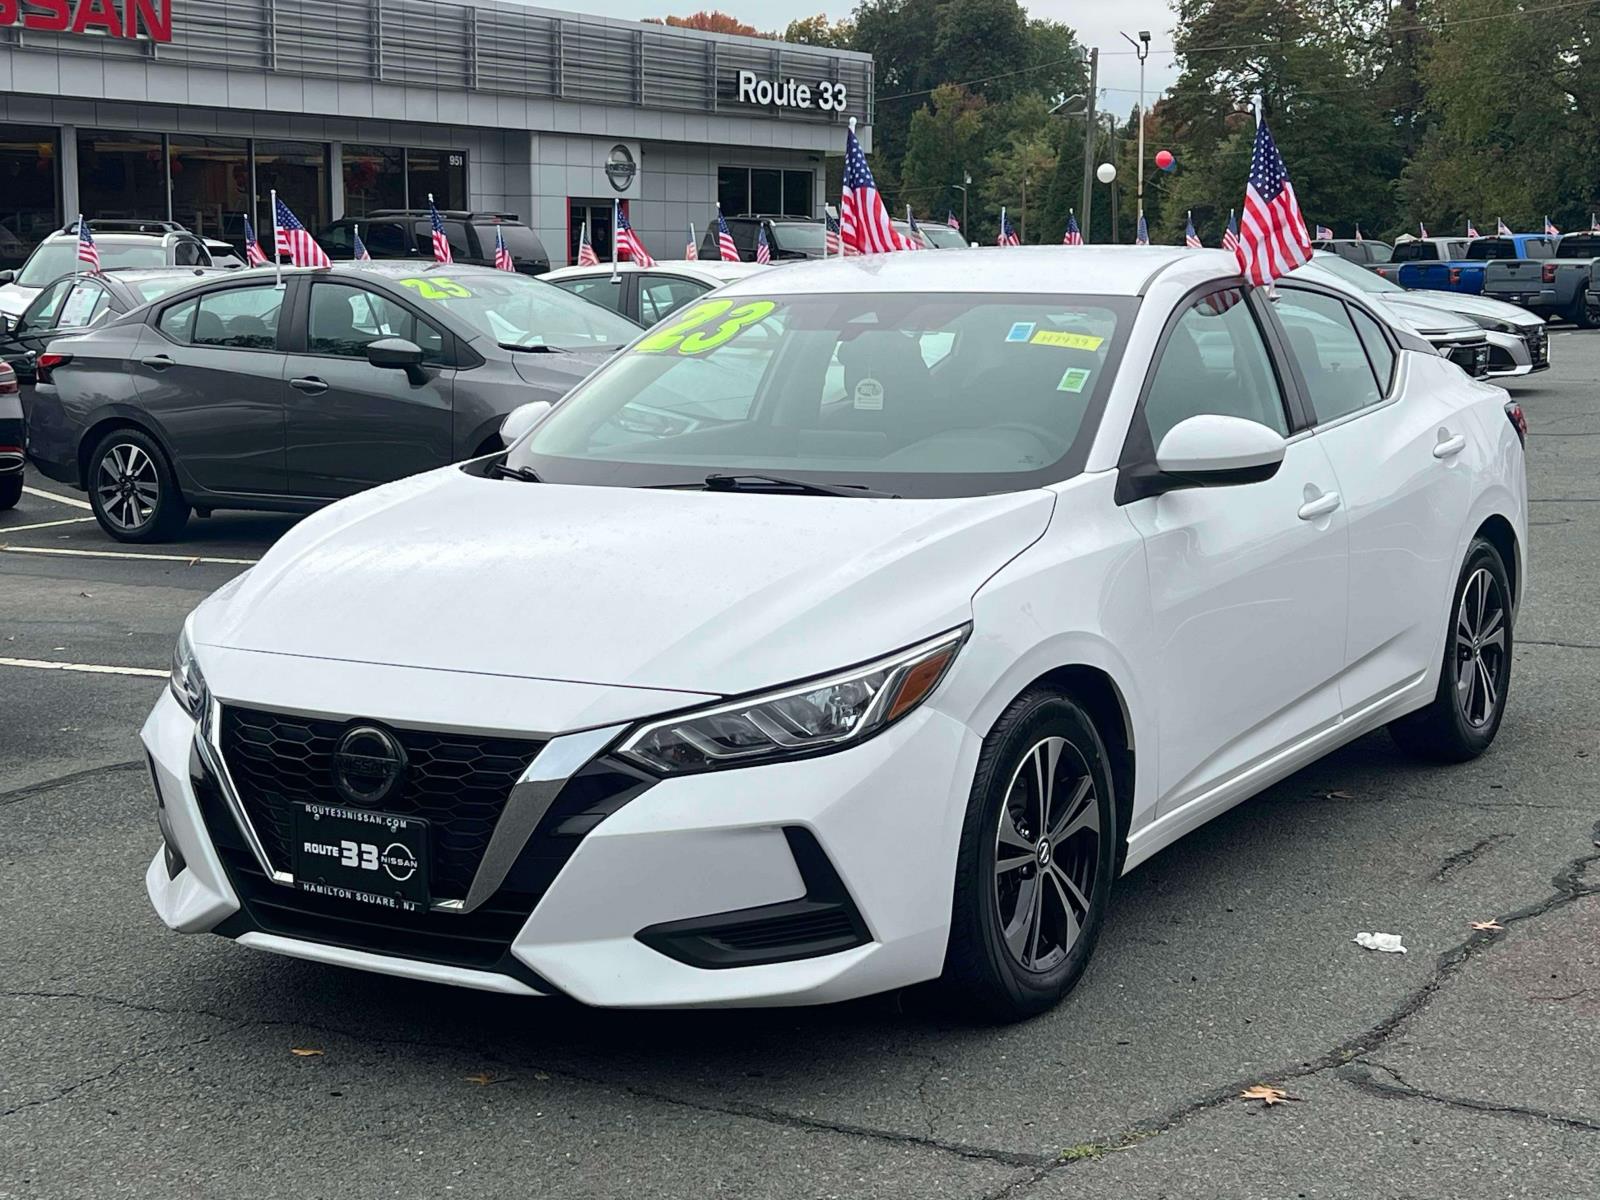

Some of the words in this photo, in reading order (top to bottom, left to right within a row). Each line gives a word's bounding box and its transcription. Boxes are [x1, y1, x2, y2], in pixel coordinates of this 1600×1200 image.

[739, 70, 811, 109] Route
[818, 81, 847, 112] 33
[449, 155, 463, 166] 951
[399, 277, 472, 300] 25
[632, 298, 776, 355] 23
[305, 804, 407, 828] ROUTE33NISSAN.COM
[303, 842, 340, 857] ROUTE
[341, 840, 379, 870] 33
[381, 855, 418, 868] NISSAN
[303, 883, 352, 899] HAMILTON
[356, 892, 399, 909] SQUARE,
[403, 901, 415, 911] NJ
